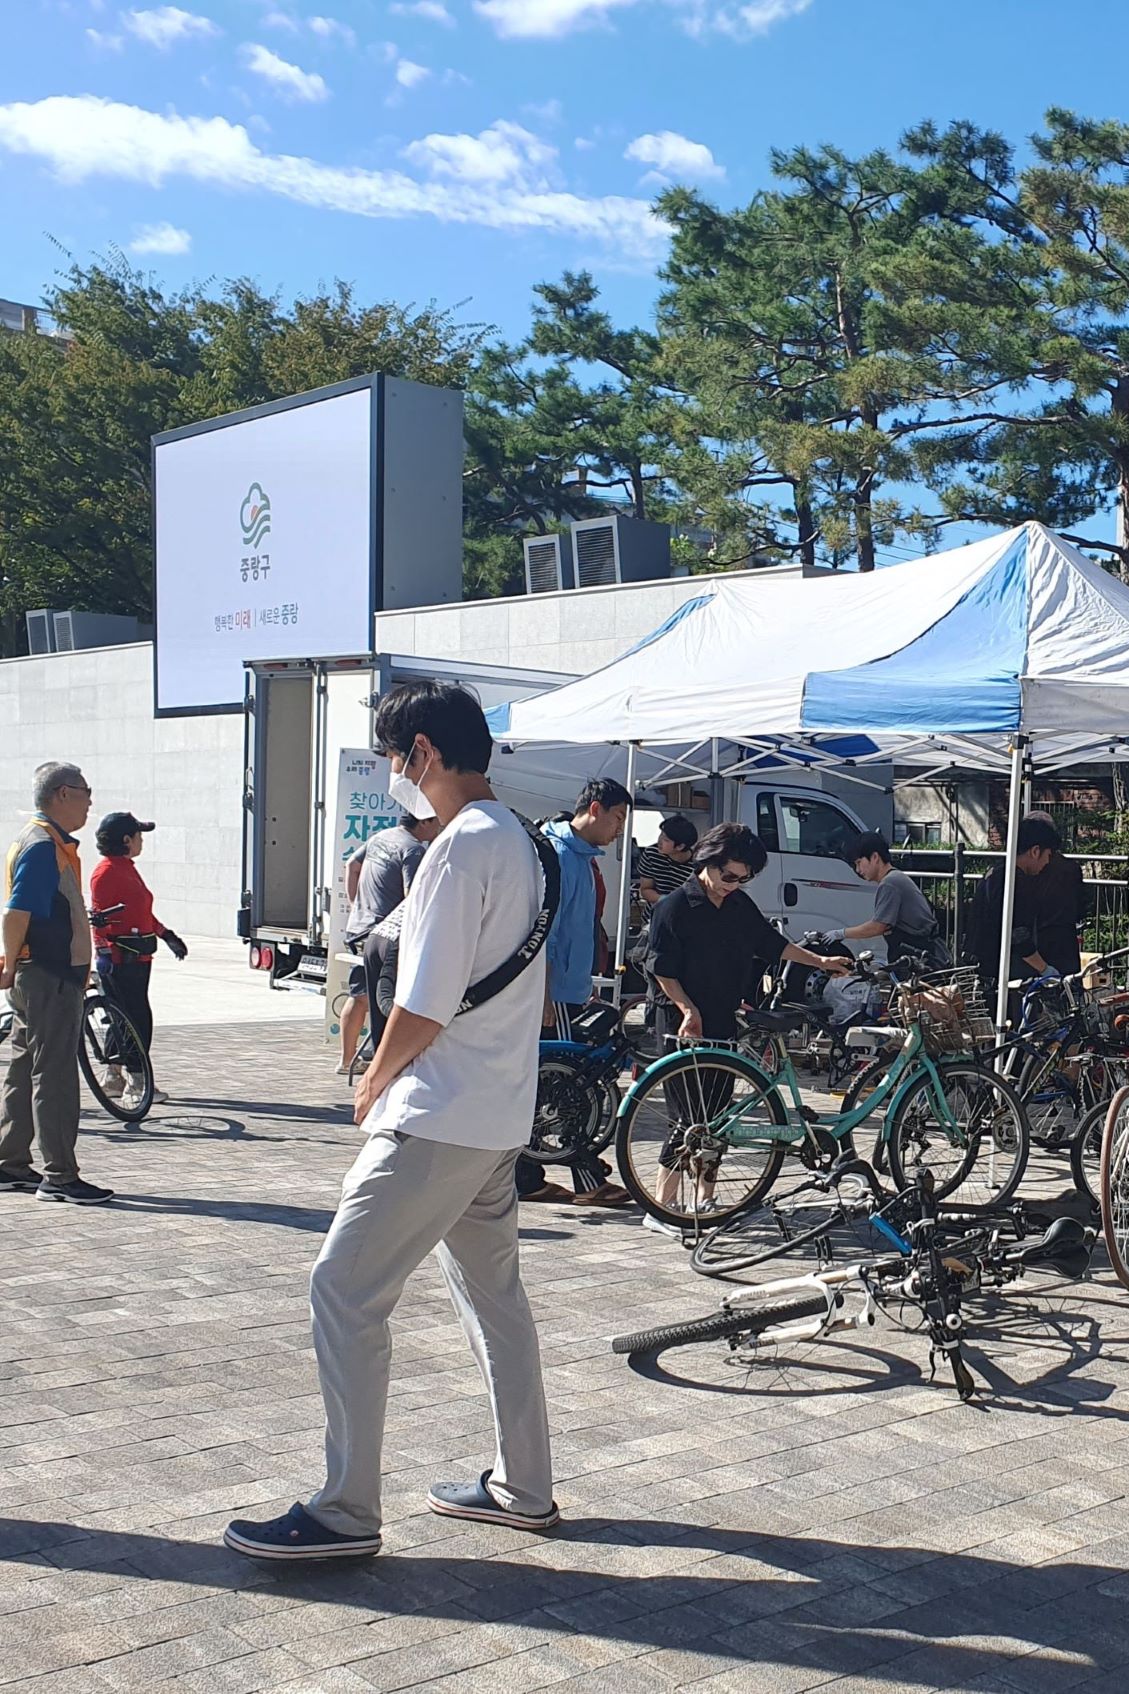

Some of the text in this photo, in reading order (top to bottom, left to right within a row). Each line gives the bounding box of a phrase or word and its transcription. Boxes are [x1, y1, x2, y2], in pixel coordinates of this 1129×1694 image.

[240, 554, 271, 583] 중랑구
[214, 602, 299, 632] 행복한 미래 새로운 중랑
